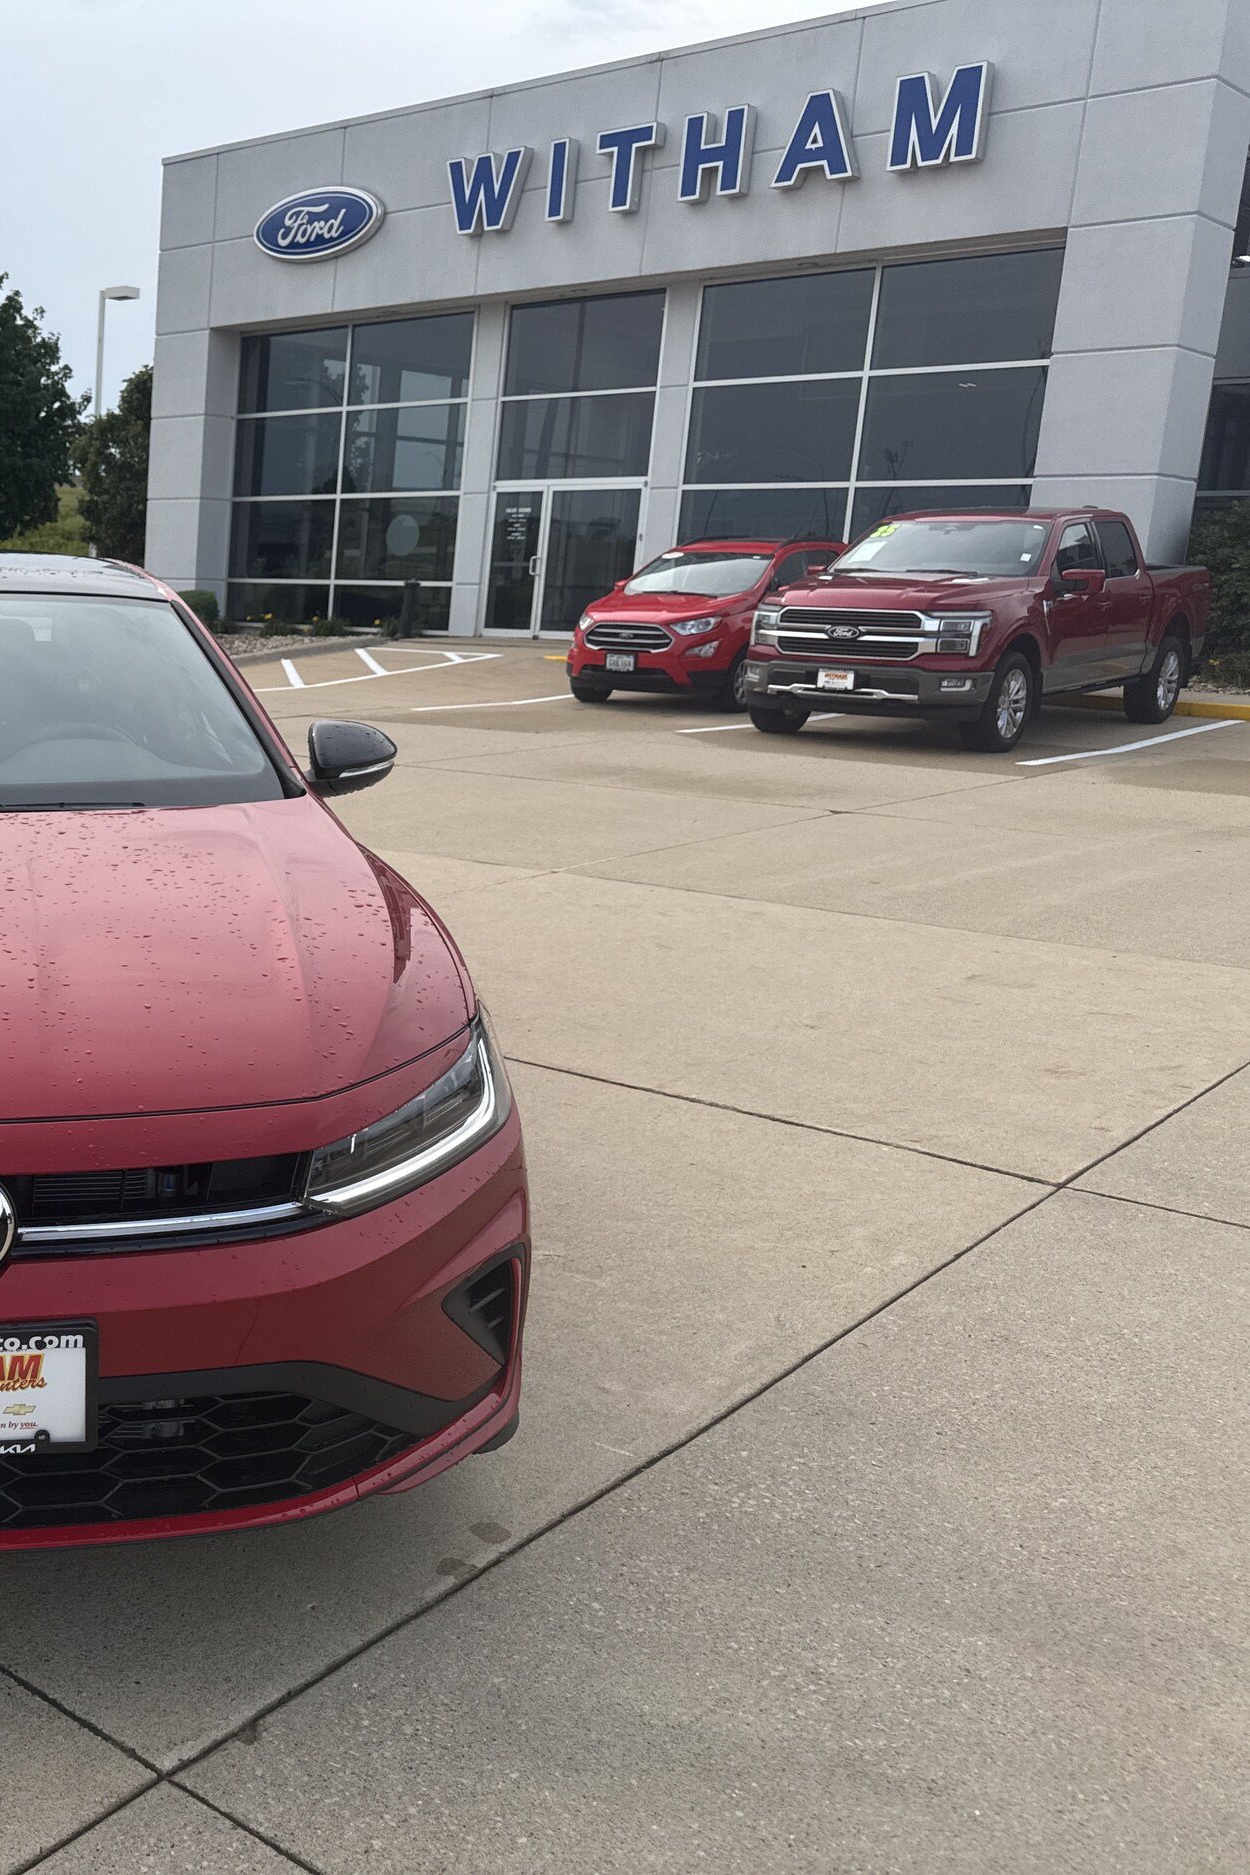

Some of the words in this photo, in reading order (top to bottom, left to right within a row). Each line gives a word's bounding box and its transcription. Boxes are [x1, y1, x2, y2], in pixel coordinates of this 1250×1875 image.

[445, 60, 992, 235] WITHAM
[277, 203, 346, 247] Ford
[8, 1421, 19, 1430] by
[19, 1421, 38, 1430] you.
